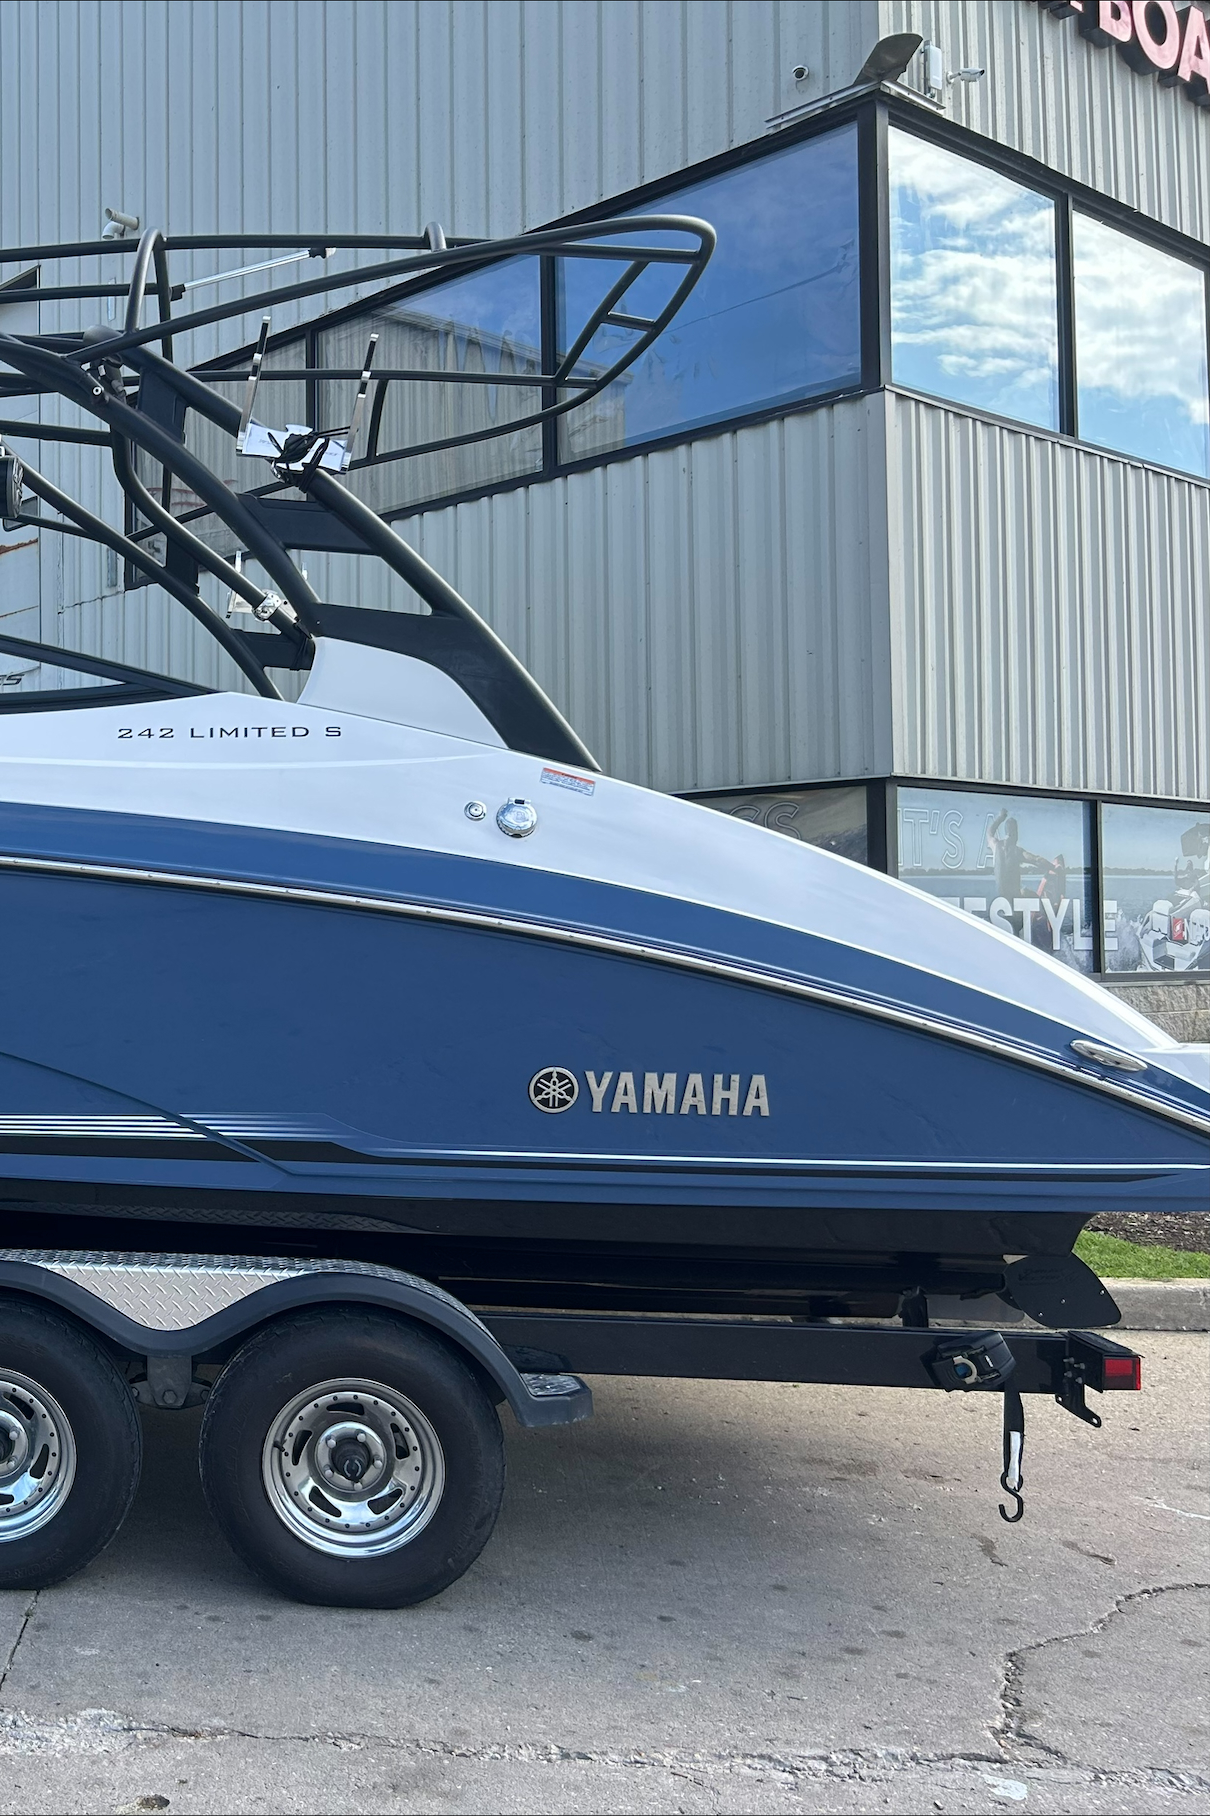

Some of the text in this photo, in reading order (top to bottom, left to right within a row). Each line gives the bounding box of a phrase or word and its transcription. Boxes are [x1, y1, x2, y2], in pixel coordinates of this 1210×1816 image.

[117, 726, 342, 740] 242 LIMITED S
[897, 807, 965, 869] IT'S
[940, 896, 1119, 951] STYLE
[584, 1070, 770, 1117] YAMAHA
